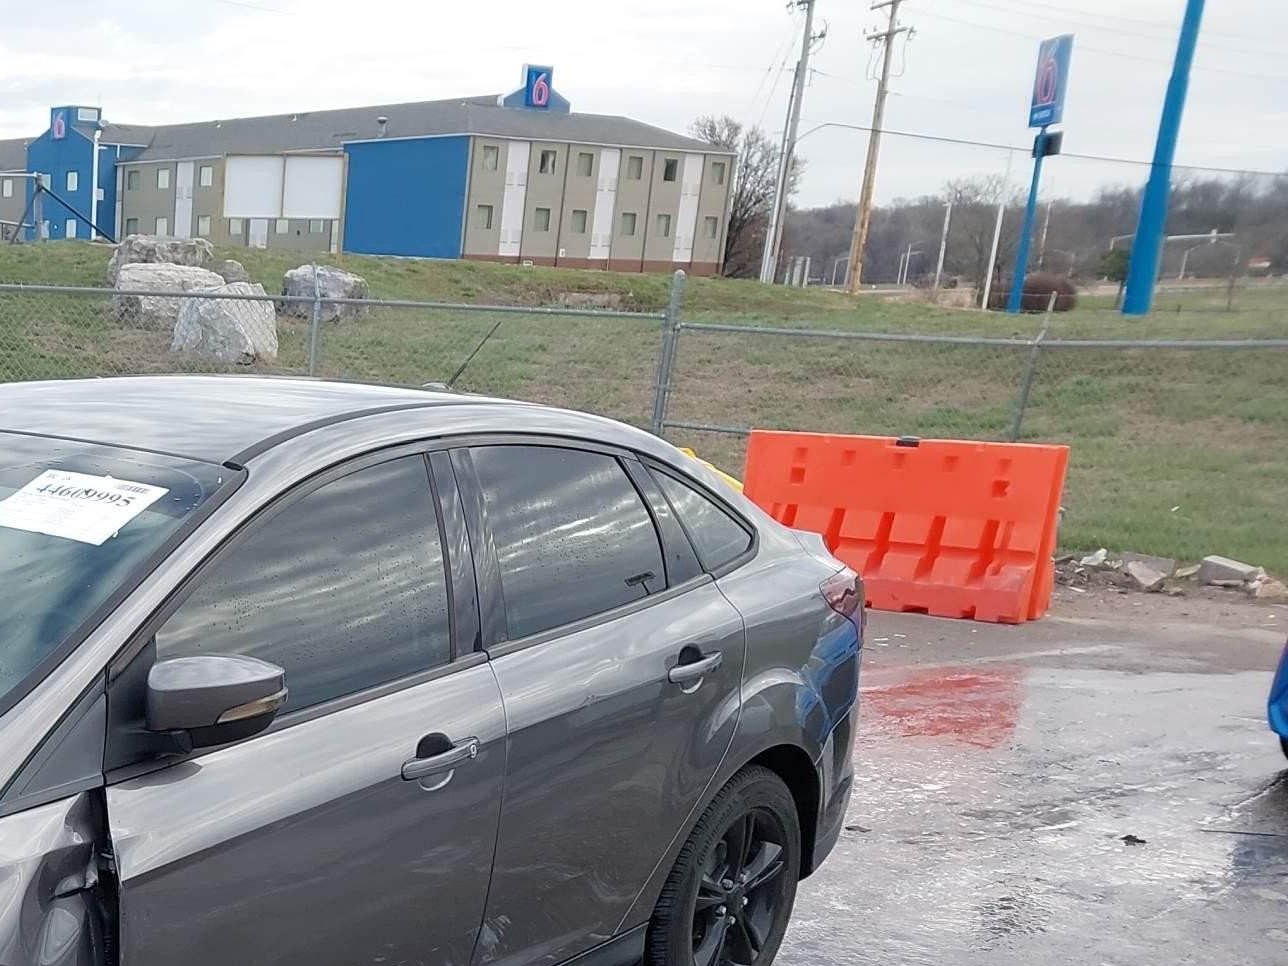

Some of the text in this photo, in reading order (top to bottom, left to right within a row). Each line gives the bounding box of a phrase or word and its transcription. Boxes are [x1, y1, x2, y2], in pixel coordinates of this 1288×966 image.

[1037, 39, 1060, 104] 6
[533, 72, 549, 106] 6
[54, 111, 66, 139] 6
[36, 483, 136, 507] 44609995
